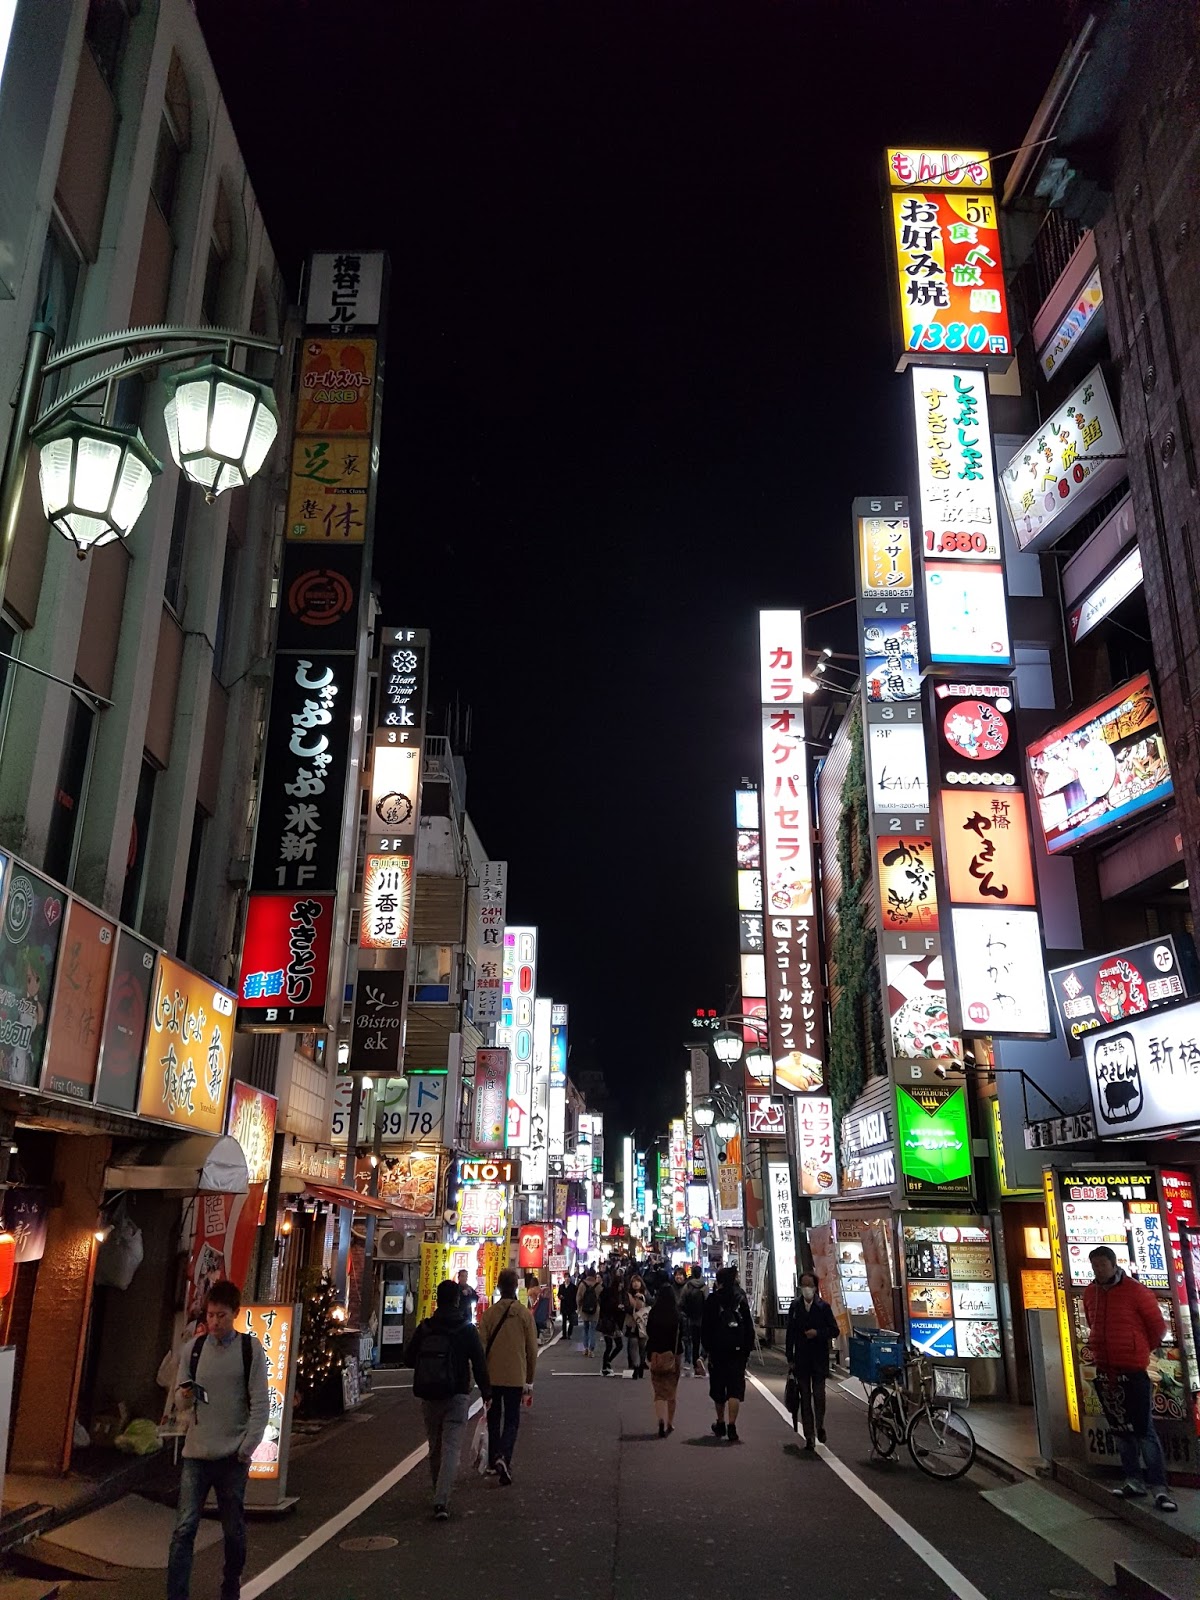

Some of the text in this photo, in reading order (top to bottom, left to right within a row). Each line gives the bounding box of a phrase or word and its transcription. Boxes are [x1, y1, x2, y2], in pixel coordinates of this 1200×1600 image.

[891, 152, 988, 185] もんじゃ
[966, 197, 993, 224] 5F
[900, 199, 950, 312] お好み焼
[329, 255, 361, 324] 梅谷ビル
[304, 370, 372, 388] ガールズバー
[313, 390, 357, 403] AKB
[920, 387, 952, 481] すきやき
[953, 375, 985, 482] しゃぶしゃぶ
[870, 501, 903, 512] 5F
[294, 525, 305, 536] 3F
[883, 520, 904, 586] マッサージ
[875, 602, 909, 613] 4F
[394, 631, 415, 642] 4F
[389, 675, 415, 684] Heart
[392, 695, 409, 705] Bar
[386, 705, 414, 727] &k
[881, 707, 915, 719] 3F
[285, 660, 339, 797] しゃぶしゃぶ
[387, 732, 408, 743] 3F
[876, 729, 893, 739] 3F
[889, 818, 925, 831] 2F
[990, 800, 1011, 830] 新橋
[280, 804, 322, 862] 米新
[380, 839, 402, 851] 2F
[962, 811, 1008, 900] やきとん
[274, 866, 317, 887] 1F
[374, 872, 398, 937] 川香苑
[481, 907, 502, 916] 24H
[101, 930, 110, 940] 3F
[392, 938, 407, 948] 2F
[898, 937, 934, 950] 1F
[144, 956, 153, 966] 2F
[286, 899, 323, 1004] やきとり
[1157, 952, 1170, 965] 2F
[986, 934, 1016, 1010] わがや
[775, 940, 797, 1050] スコールカフェ
[795, 918, 816, 1051] スイーツ&ガレット
[154, 964, 207, 1045] しゃぶしゃぶ
[217, 996, 229, 1010] 1F
[357, 1014, 399, 1029] Bistro
[514, 933, 535, 1096] ROBOT
[364, 1031, 388, 1050] &k
[1149, 1036, 1200, 1076] 新橋
[1097, 1056, 1139, 1084] やきとん
[50, 1077, 84, 1098] First Class
[911, 1090, 950, 1098] HAZELBURN
[800, 1101, 816, 1147] パセラ
[818, 1100, 833, 1164] カラオケ
[909, 1183, 923, 1191] B1F
[1064, 1176, 1152, 1186] ALL YOU CAN EAT
[461, 1190, 502, 1213] 風俗
[460, 1213, 501, 1236] 案内
[777, 1187, 792, 1243] 相席酒場
[1144, 1216, 1165, 1271] 飲み放題
